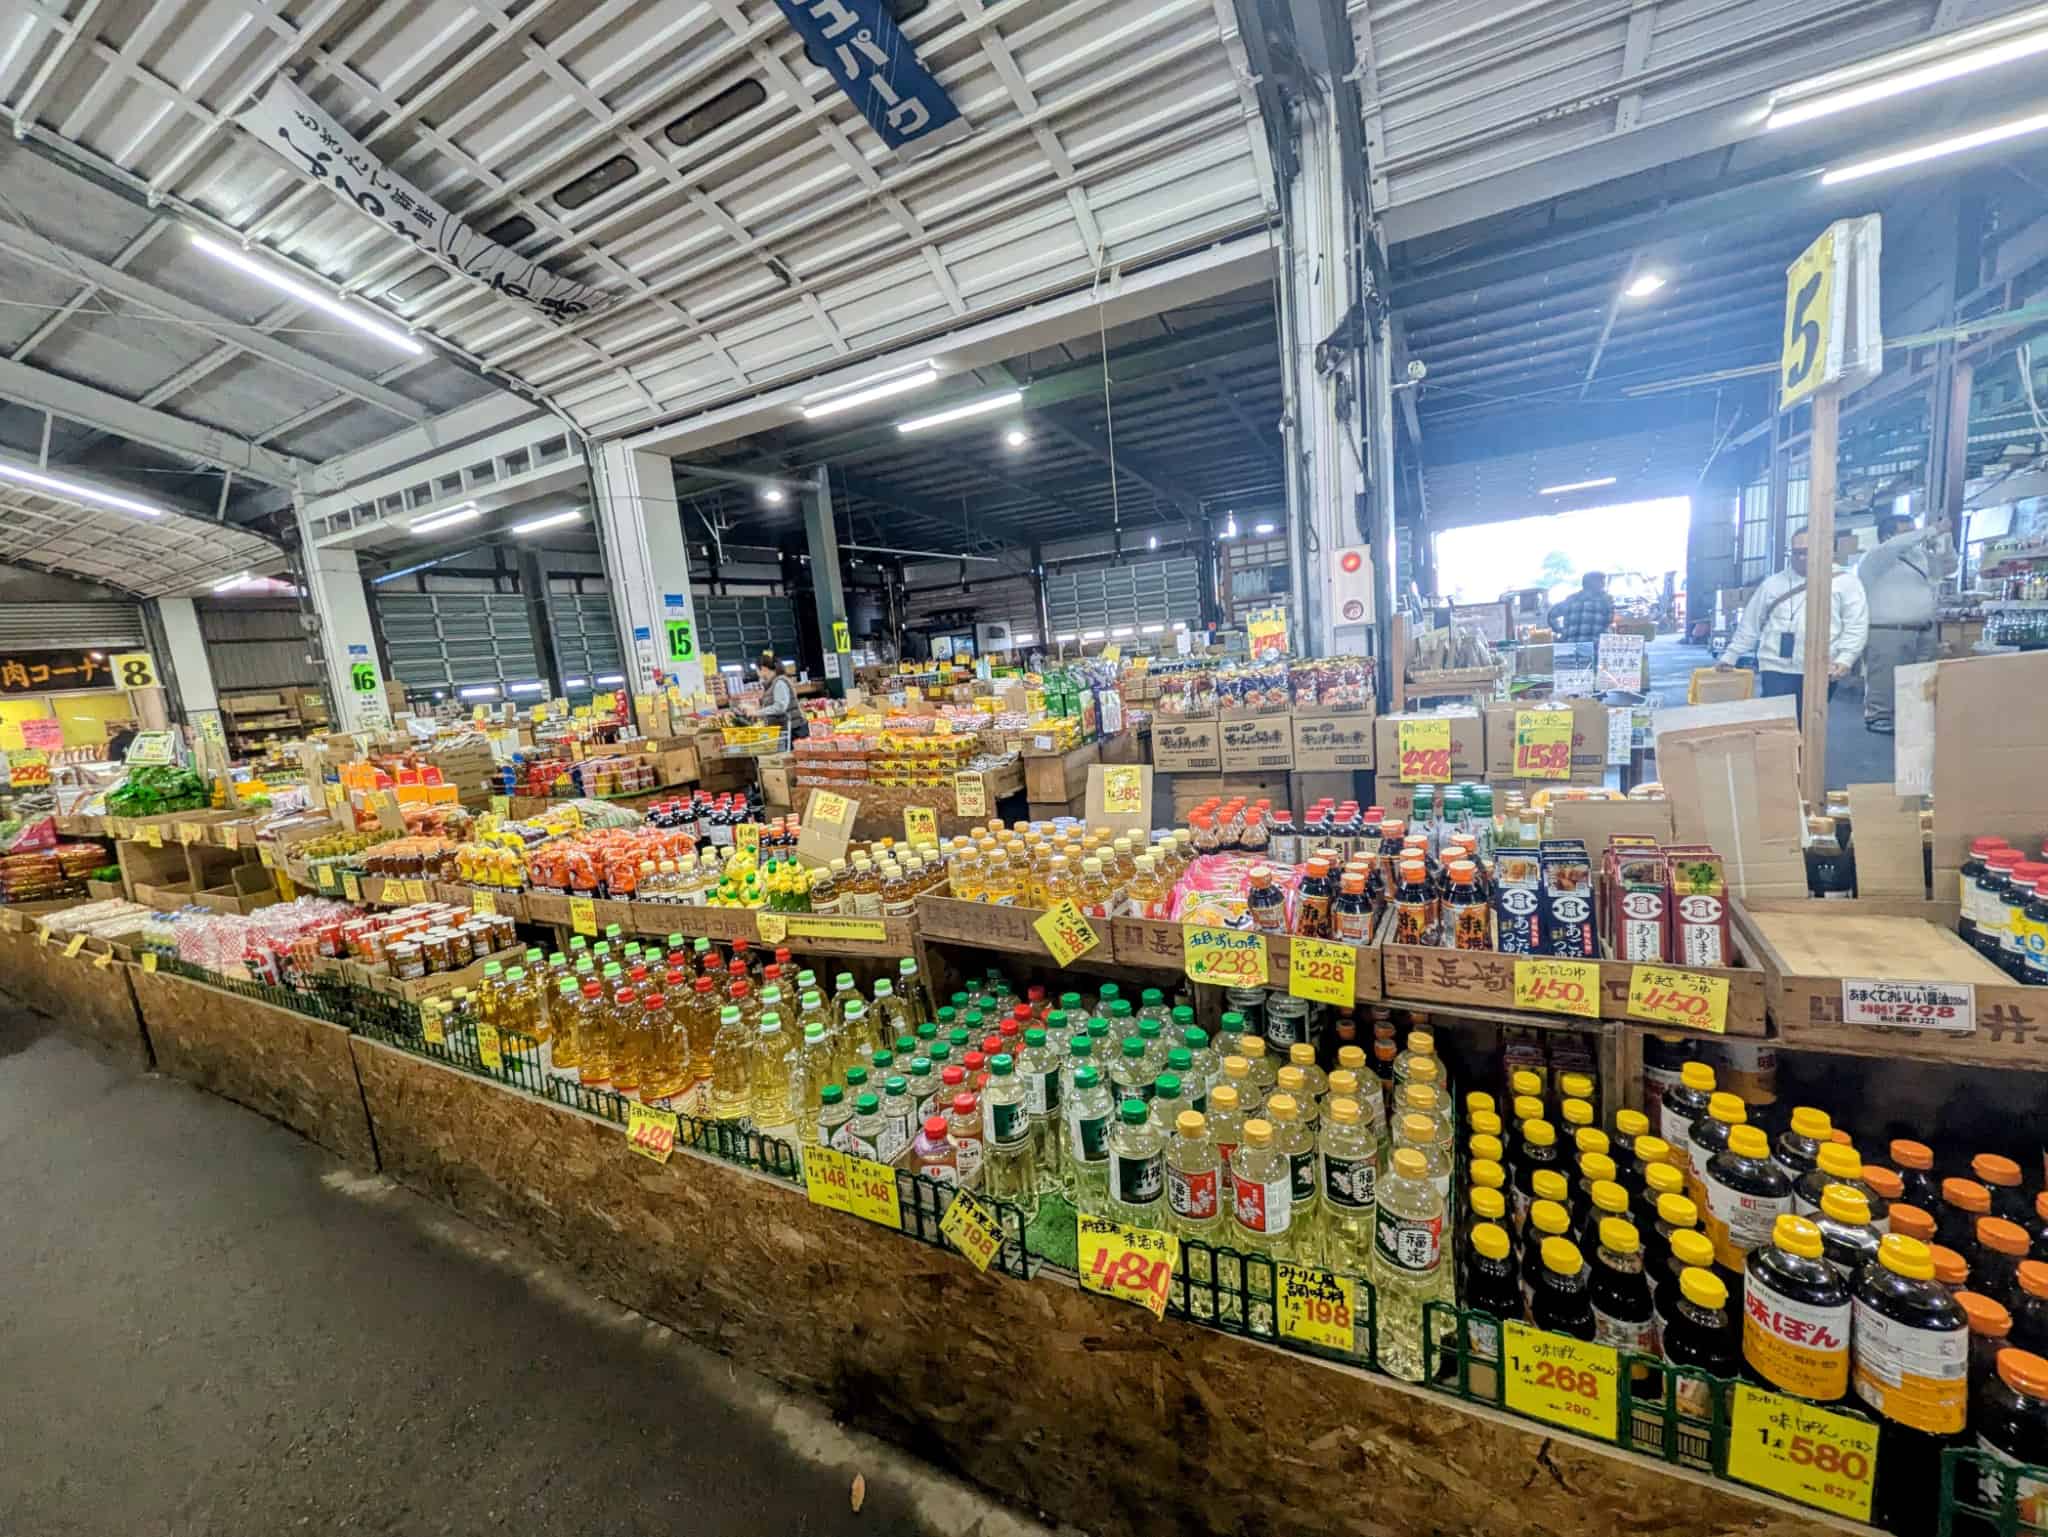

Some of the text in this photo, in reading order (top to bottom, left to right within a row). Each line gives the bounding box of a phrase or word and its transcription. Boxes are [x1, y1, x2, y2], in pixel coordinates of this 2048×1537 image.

[1788, 272, 1824, 389] 5
[668, 627, 692, 657] 15
[123, 661, 152, 686] 8
[353, 671, 376, 691] 16
[1402, 750, 1450, 776] 298
[1518, 744, 1569, 769] 158
[1059, 926, 1085, 953] 298
[1206, 949, 1260, 975] 238
[1308, 960, 1345, 985] 228
[1529, 977, 1585, 1003] 450
[1642, 988, 1709, 1015] 450
[1896, 1004, 1956, 1018] 298
[821, 1168, 846, 1187] 148
[863, 1181, 890, 1202] 148
[962, 1221, 994, 1256] 198
[1405, 1232, 1427, 1264] 福泉
[1092, 1247, 1171, 1303] 480
[1279, 1265, 1340, 1290] みりん風
[1286, 1280, 1346, 1308] 調味料
[1304, 1298, 1350, 1329] 198
[1746, 1290, 1841, 1349] 味ぽん
[1532, 1343, 1584, 1362] 味ぽん
[1536, 1360, 1599, 1399] 268
[1769, 1411, 1838, 1439] 味ぽん
[1789, 1434, 1869, 1481] 580
